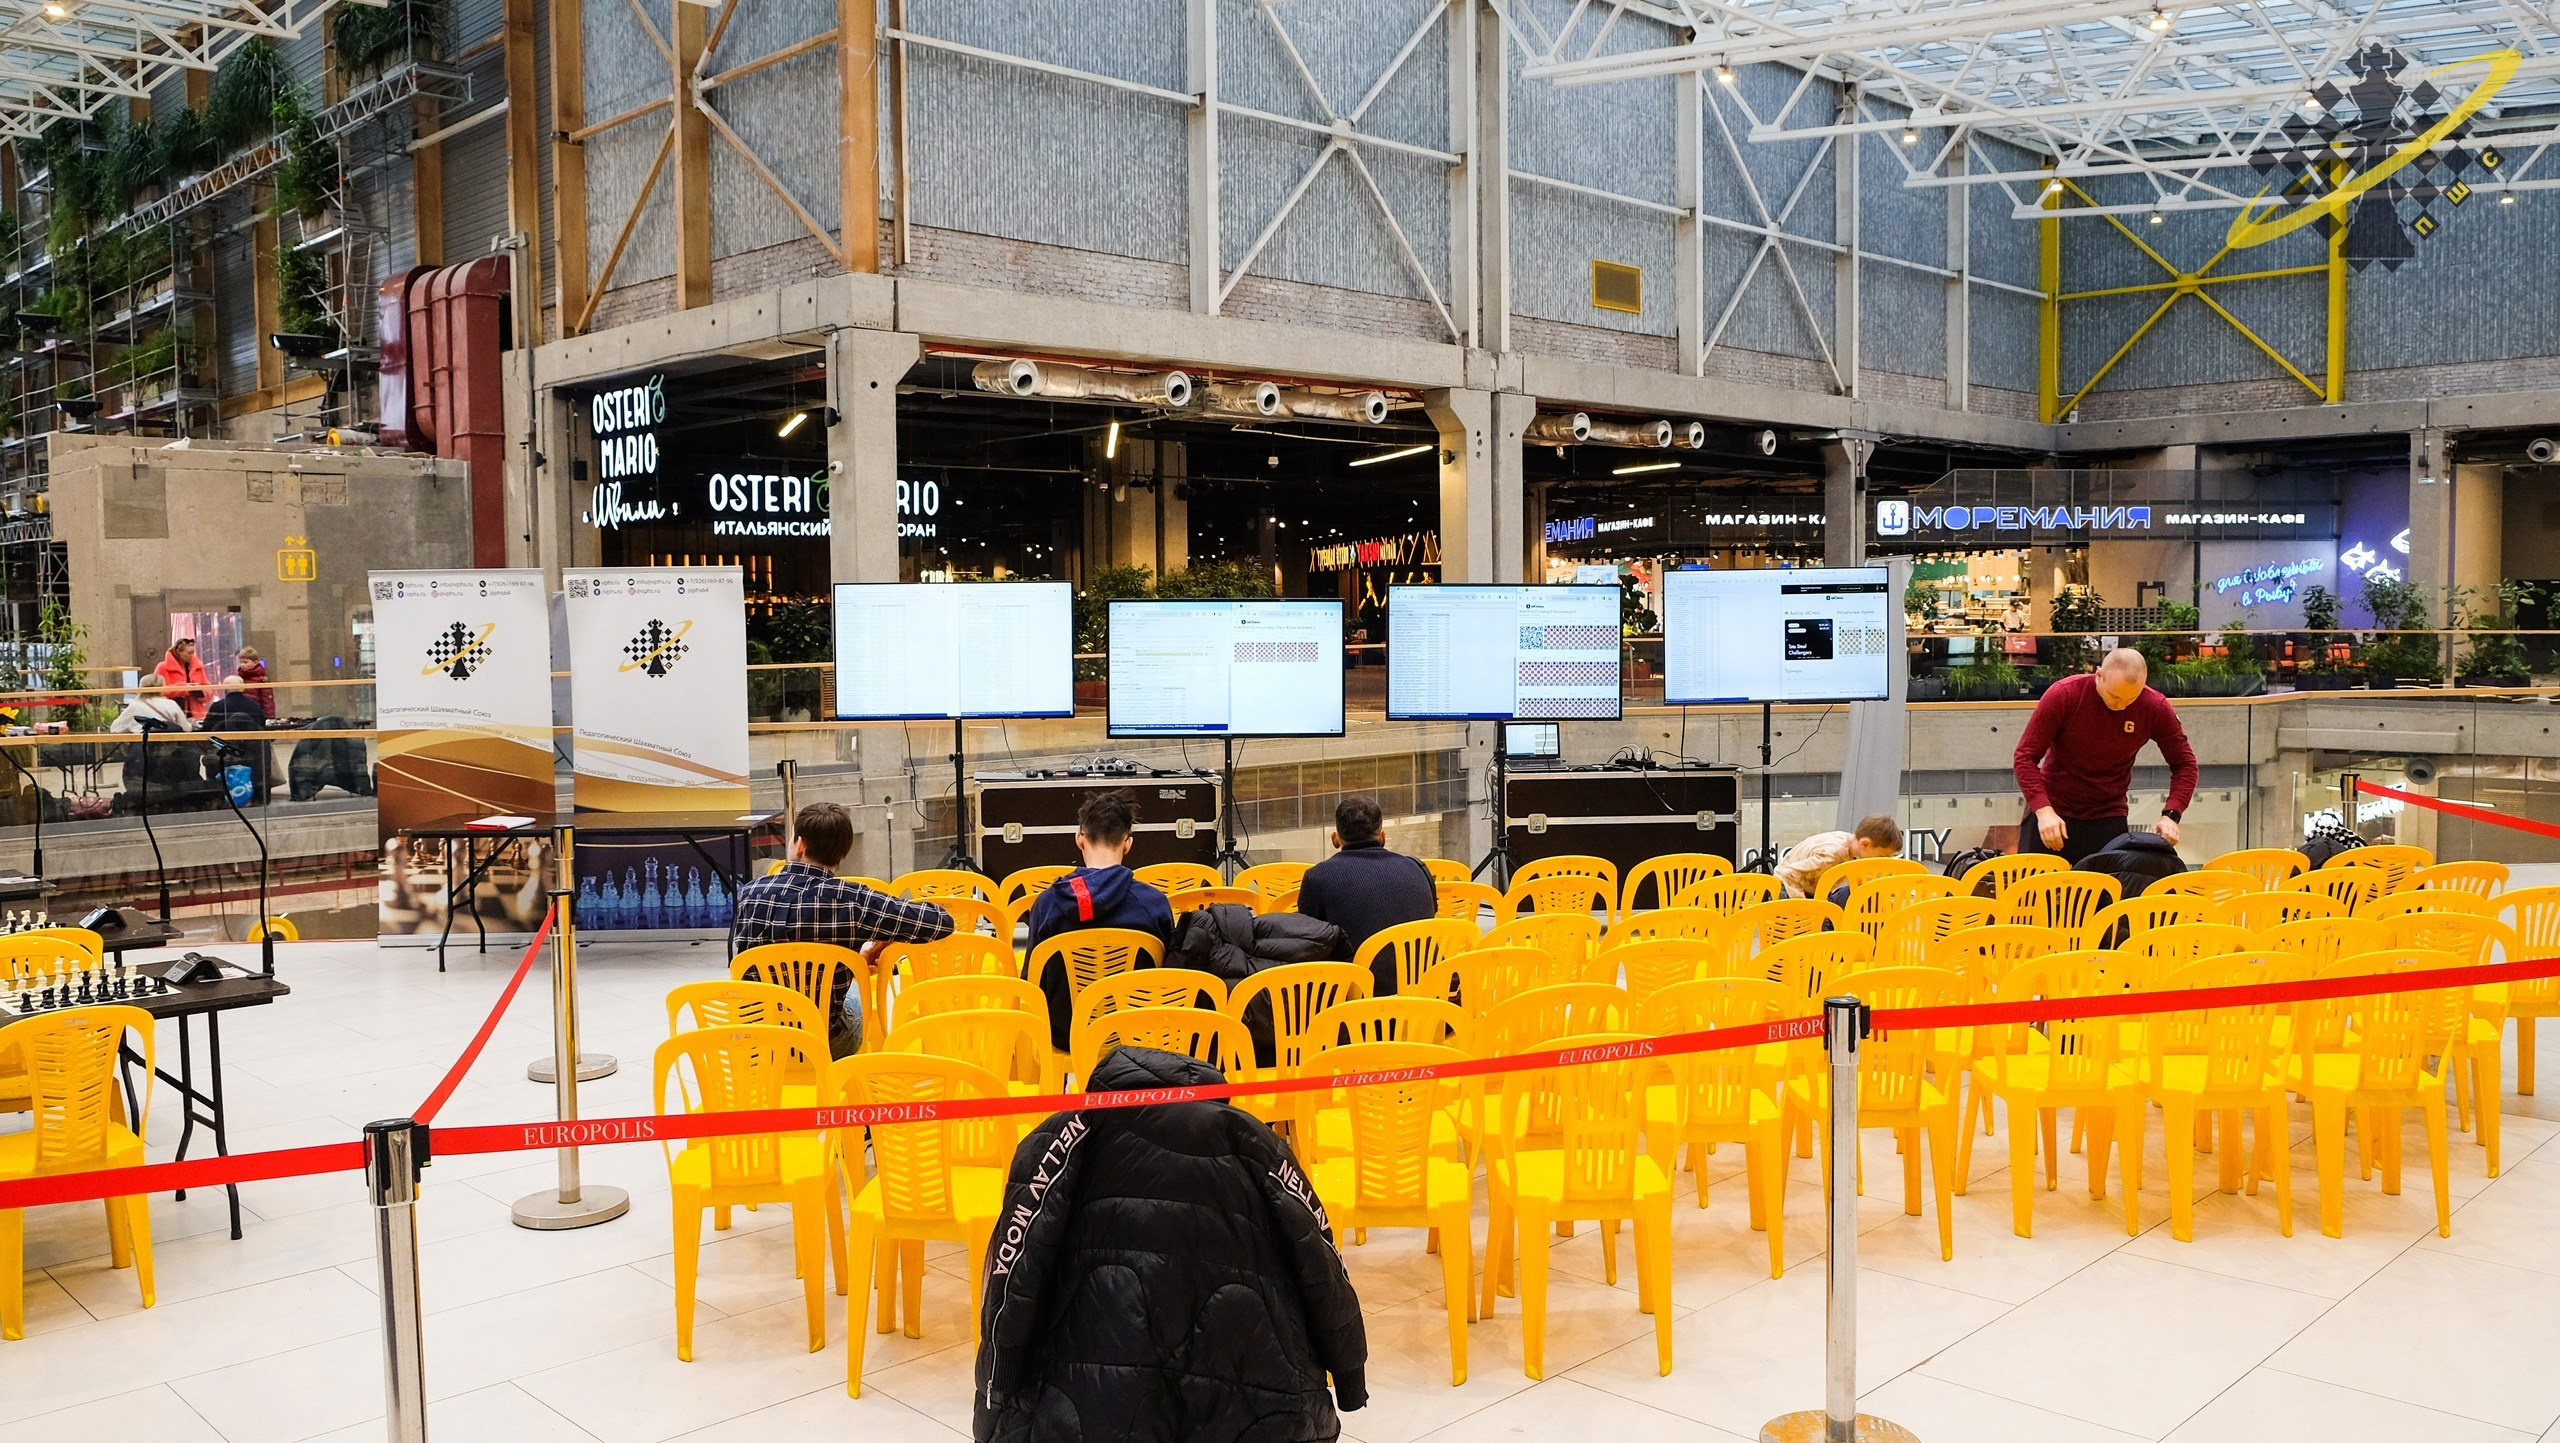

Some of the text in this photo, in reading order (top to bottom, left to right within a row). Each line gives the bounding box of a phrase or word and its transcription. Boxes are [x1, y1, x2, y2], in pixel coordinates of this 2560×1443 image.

[601, 432, 657, 478] MARIO
[592, 480, 666, 531] Швили
[896, 480, 939, 516] RIO
[713, 518, 937, 537] ИТАЛЬЯНСКИЙ ОРАН
[1546, 516, 1595, 542] ЕМАНИЯ
[1705, 514, 1826, 526] МАГАЗИН-К
[1913, 506, 2306, 530] МОРЕМАНИЯ МАГАЗИН-КАФЕ
[378, 706, 493, 719] Педагогический Шахматный Союз
[2124, 721, 2135, 733] G
[579, 728, 692, 759] Педагогический Шахматный Союз
[1768, 1017, 1826, 1040] EUROP
[1558, 1041, 1654, 1065] EUROPOLIS
[1331, 1067, 1435, 1087] EUROPOLIS
[1084, 1087, 1196, 1107] EUROPOLIS
[815, 1104, 937, 1126] EUROPOLIS
[523, 1120, 655, 1146] EUROPOLIS
[993, 1114, 1086, 1275] NELLAV MODA
